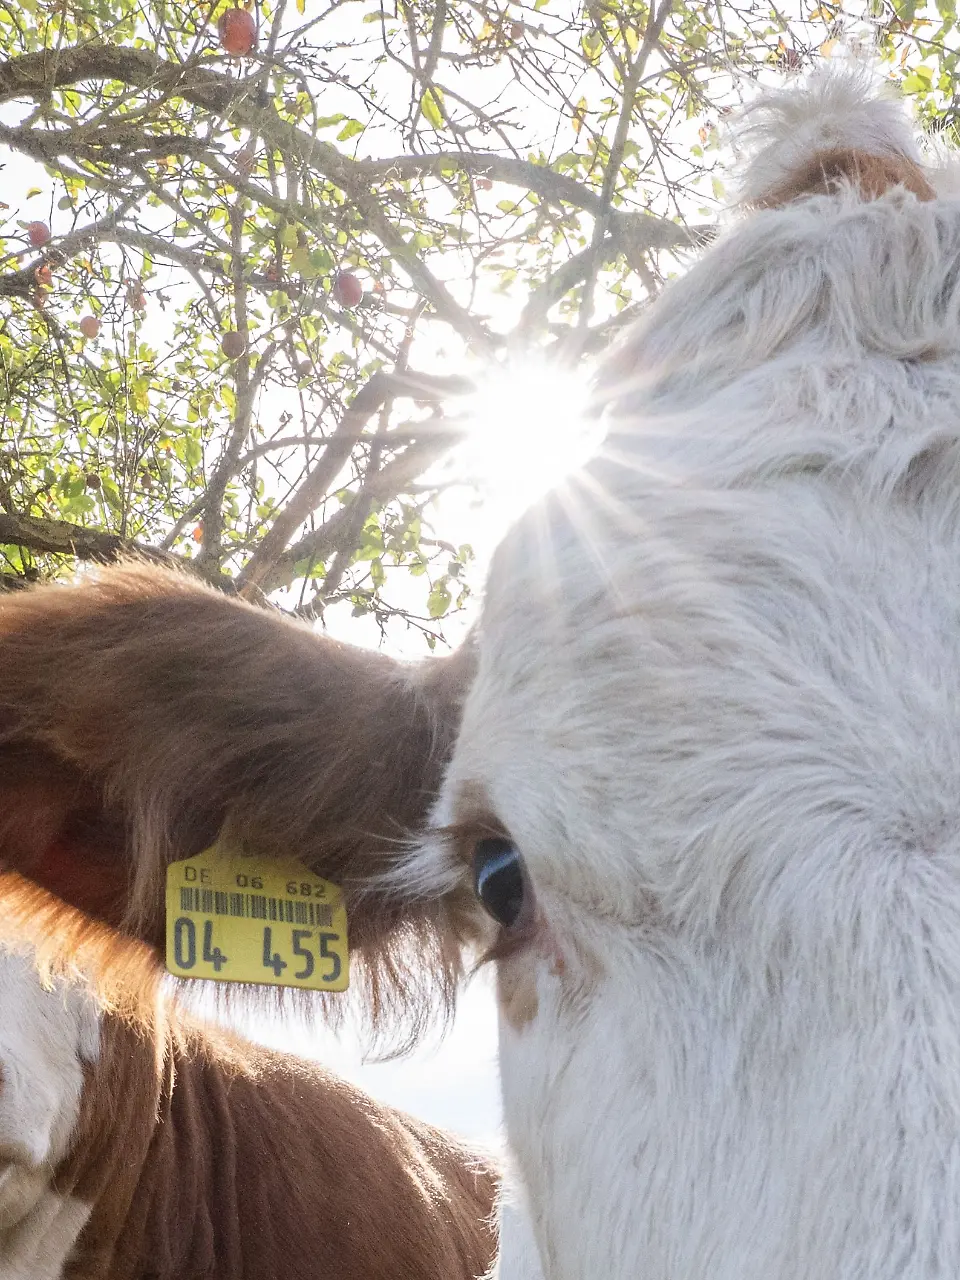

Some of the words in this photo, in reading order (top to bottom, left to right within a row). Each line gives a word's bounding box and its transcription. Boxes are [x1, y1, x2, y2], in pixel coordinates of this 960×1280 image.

[184, 866, 211, 884] DE
[236, 873, 264, 889] 06
[286, 881, 326, 898] 682
[174, 917, 228, 972] 04
[262, 927, 341, 982] 455
